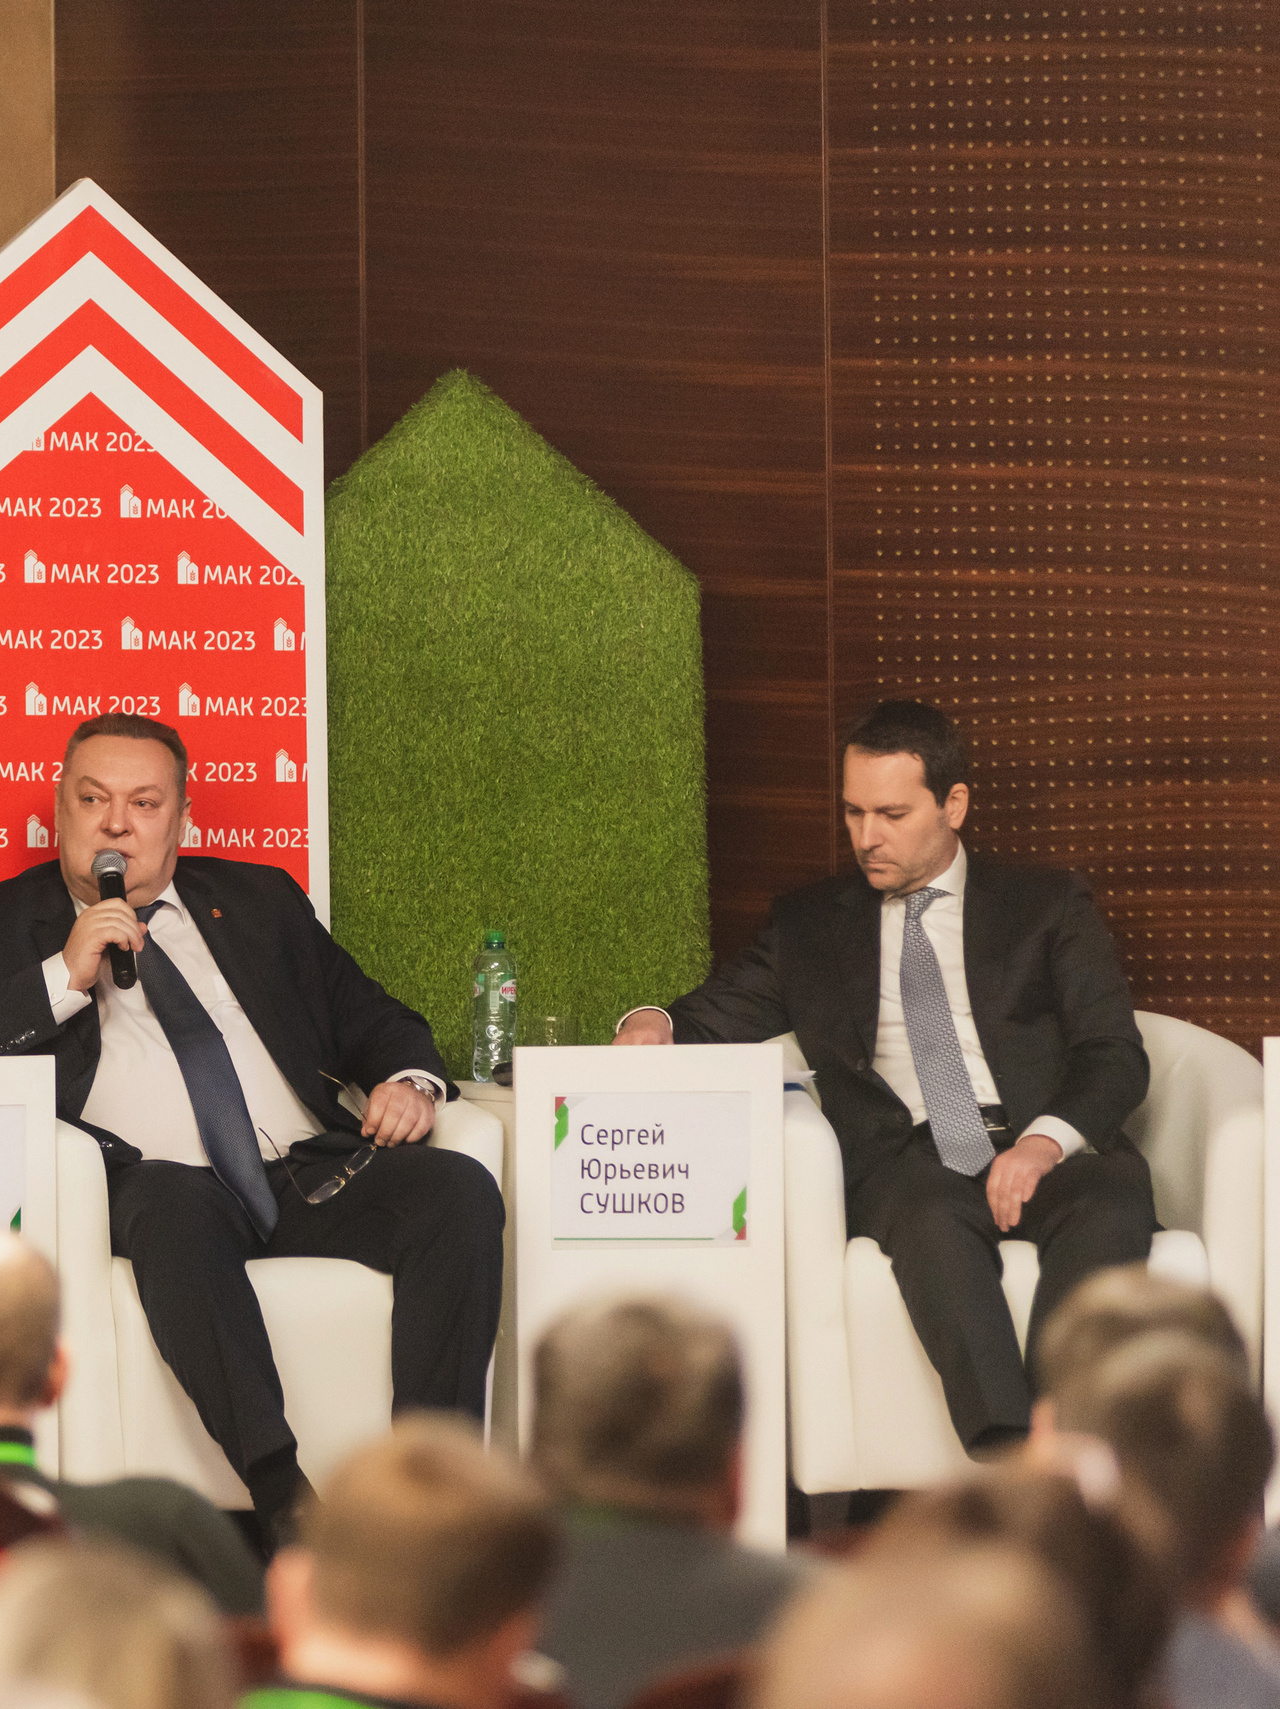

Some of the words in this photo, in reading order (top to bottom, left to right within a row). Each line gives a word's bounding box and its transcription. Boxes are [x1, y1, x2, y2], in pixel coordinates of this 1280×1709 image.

[49, 431, 99, 452] МАК
[105, 431, 157, 453] 202
[48, 496, 102, 518] 2023
[146, 498, 196, 519] МАК
[50, 563, 101, 584] МАК
[106, 563, 160, 585] 2023
[203, 564, 253, 585] МАК
[259, 564, 304, 586] 202
[50, 629, 103, 650] 2023
[147, 630, 197, 651] МАК
[203, 630, 256, 651] 2023
[51, 695, 102, 716] МАК
[108, 695, 161, 717] 2023
[205, 696, 254, 717] МАК
[204, 761, 258, 783] 2023
[206, 828, 256, 848] МАК
[580, 1123, 665, 1152] Сергей
[580, 1158, 690, 1186] Юрьевич
[580, 1192, 686, 1215] СУШКОВ
